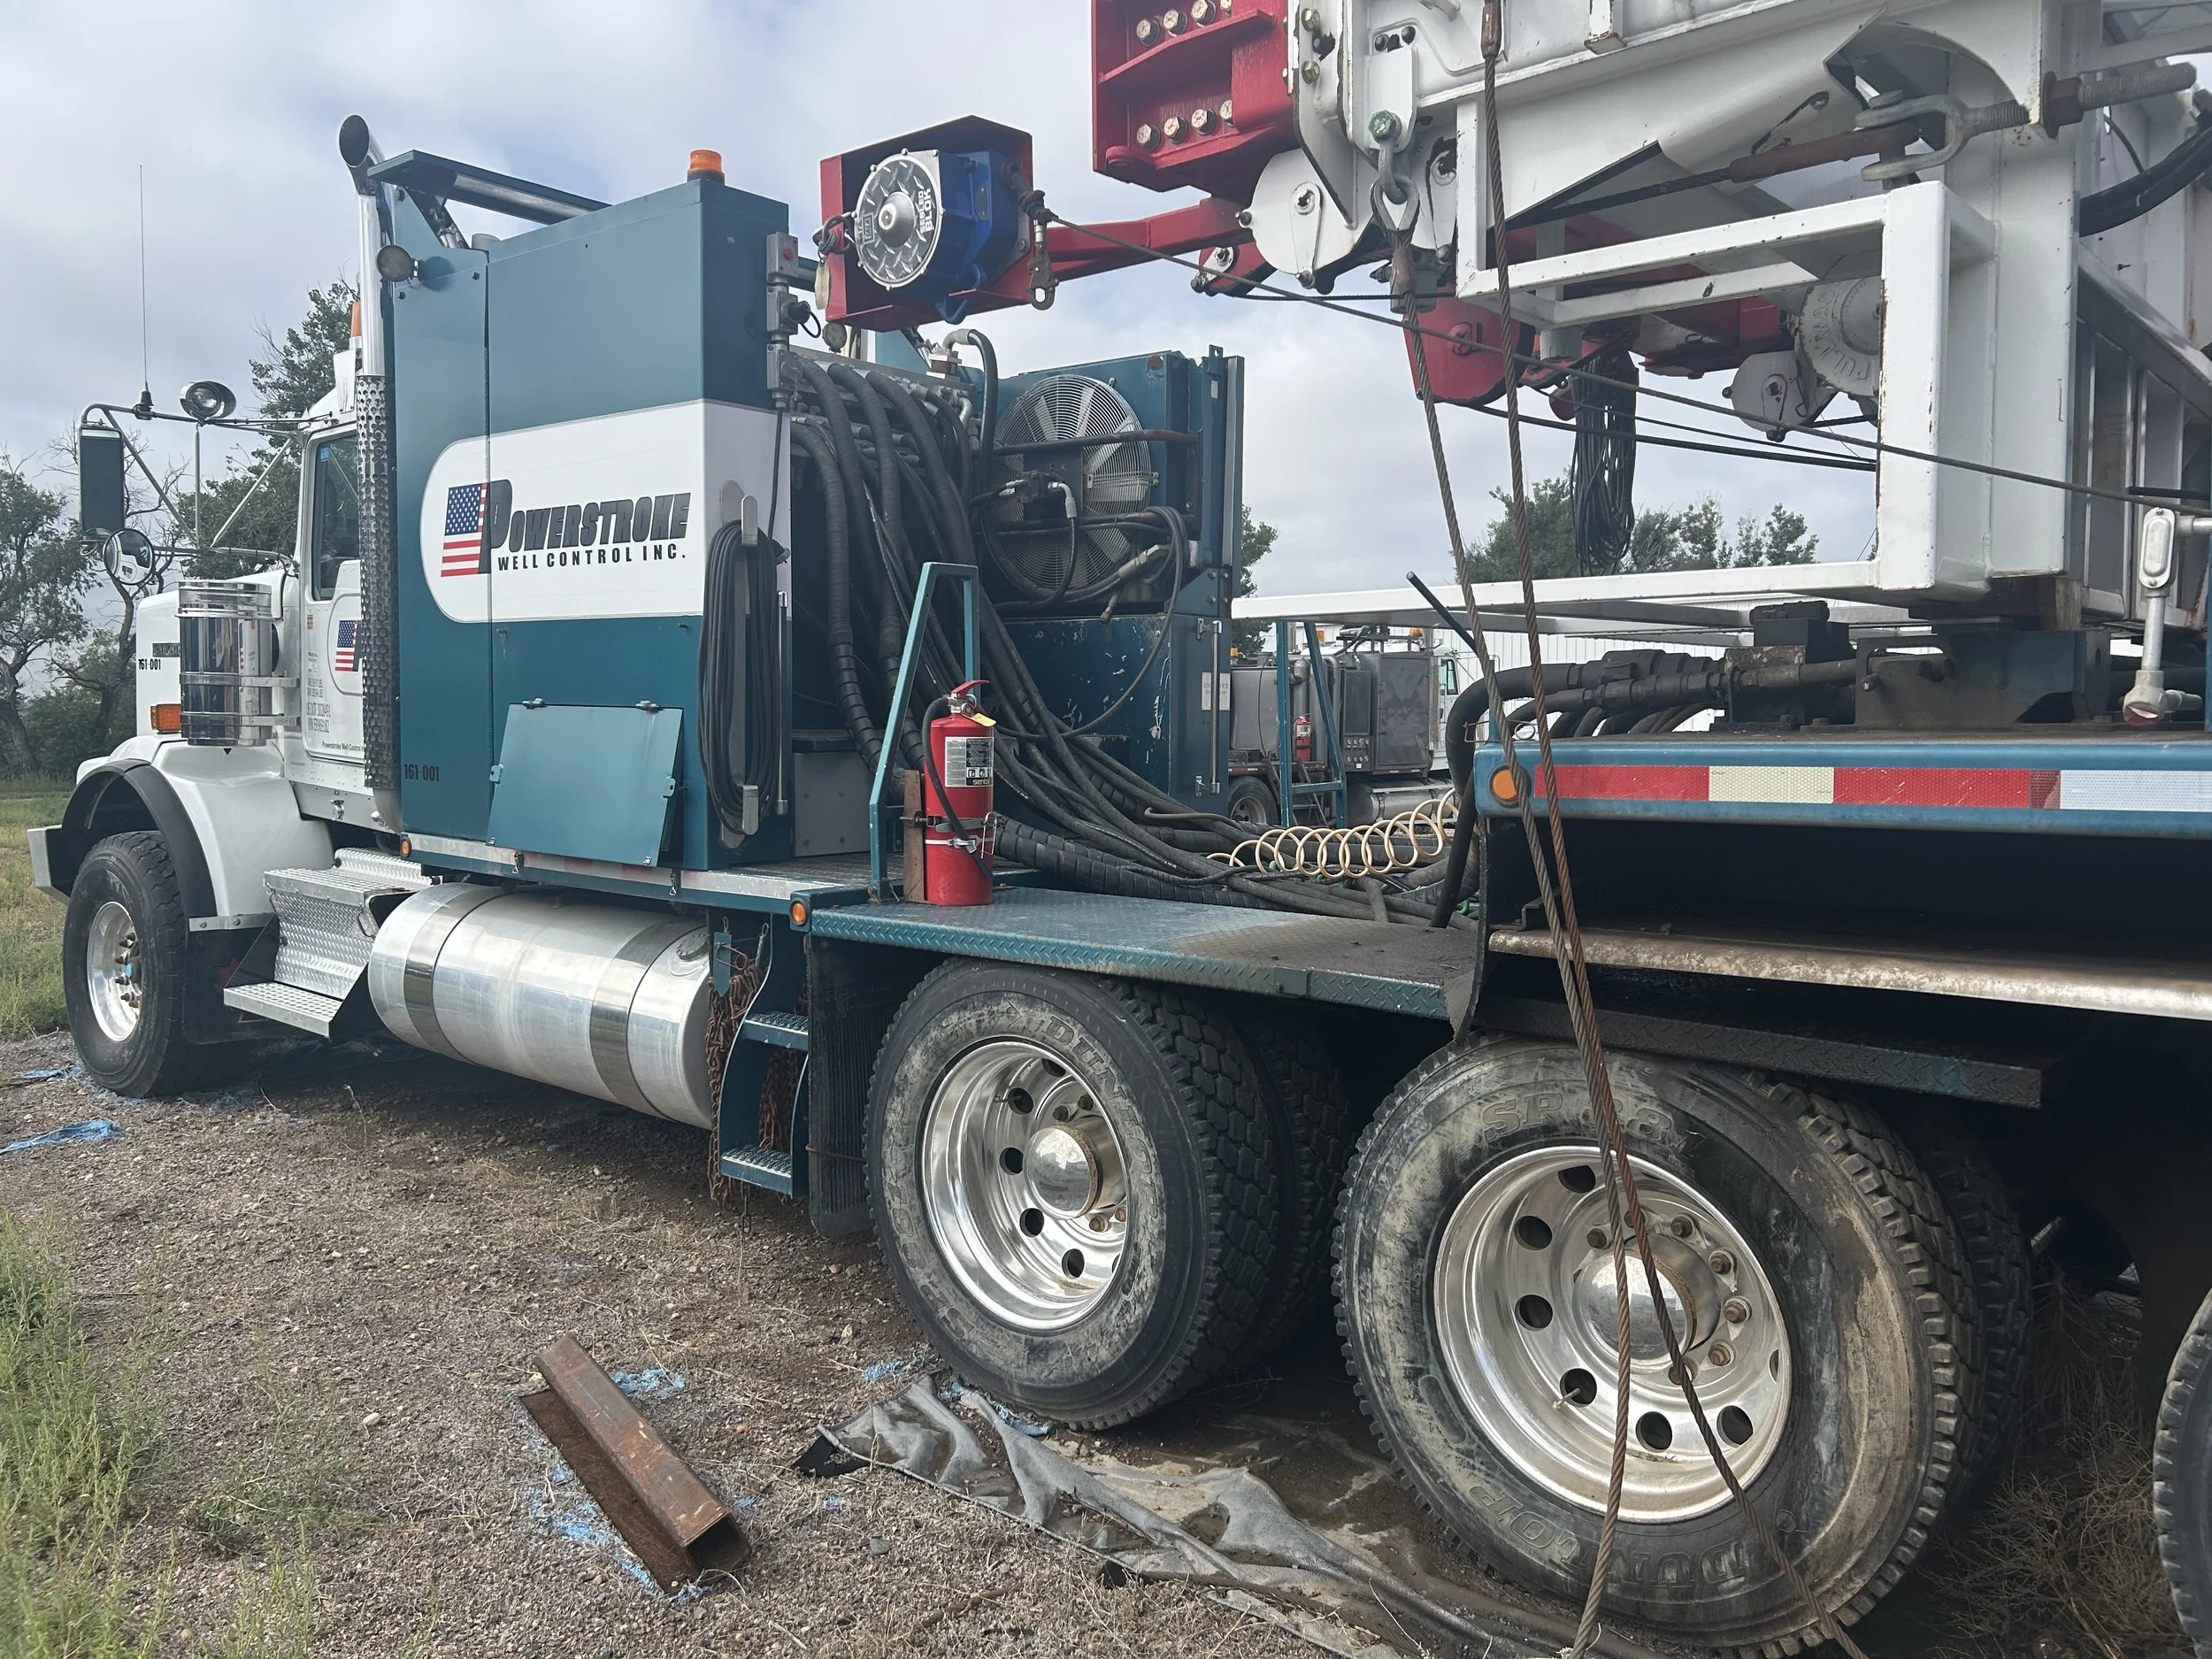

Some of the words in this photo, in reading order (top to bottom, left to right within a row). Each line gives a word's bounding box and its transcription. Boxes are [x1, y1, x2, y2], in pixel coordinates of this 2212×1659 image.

[924, 188, 934, 233] BLOK
[1813, 288, 1870, 380] PULLMAS
[478, 479, 692, 574] POWERSTROKE
[498, 553, 538, 571] WELL
[547, 546, 633, 568] CONTROL
[642, 543, 687, 561] INC.
[138, 658, 161, 670] 161-001
[403, 764, 439, 782] 161-001
[1047, 1014, 1159, 1219] DUNLOP
[1482, 1092, 1563, 1143] SP
[1469, 1486, 1750, 1589] DUNLOP
